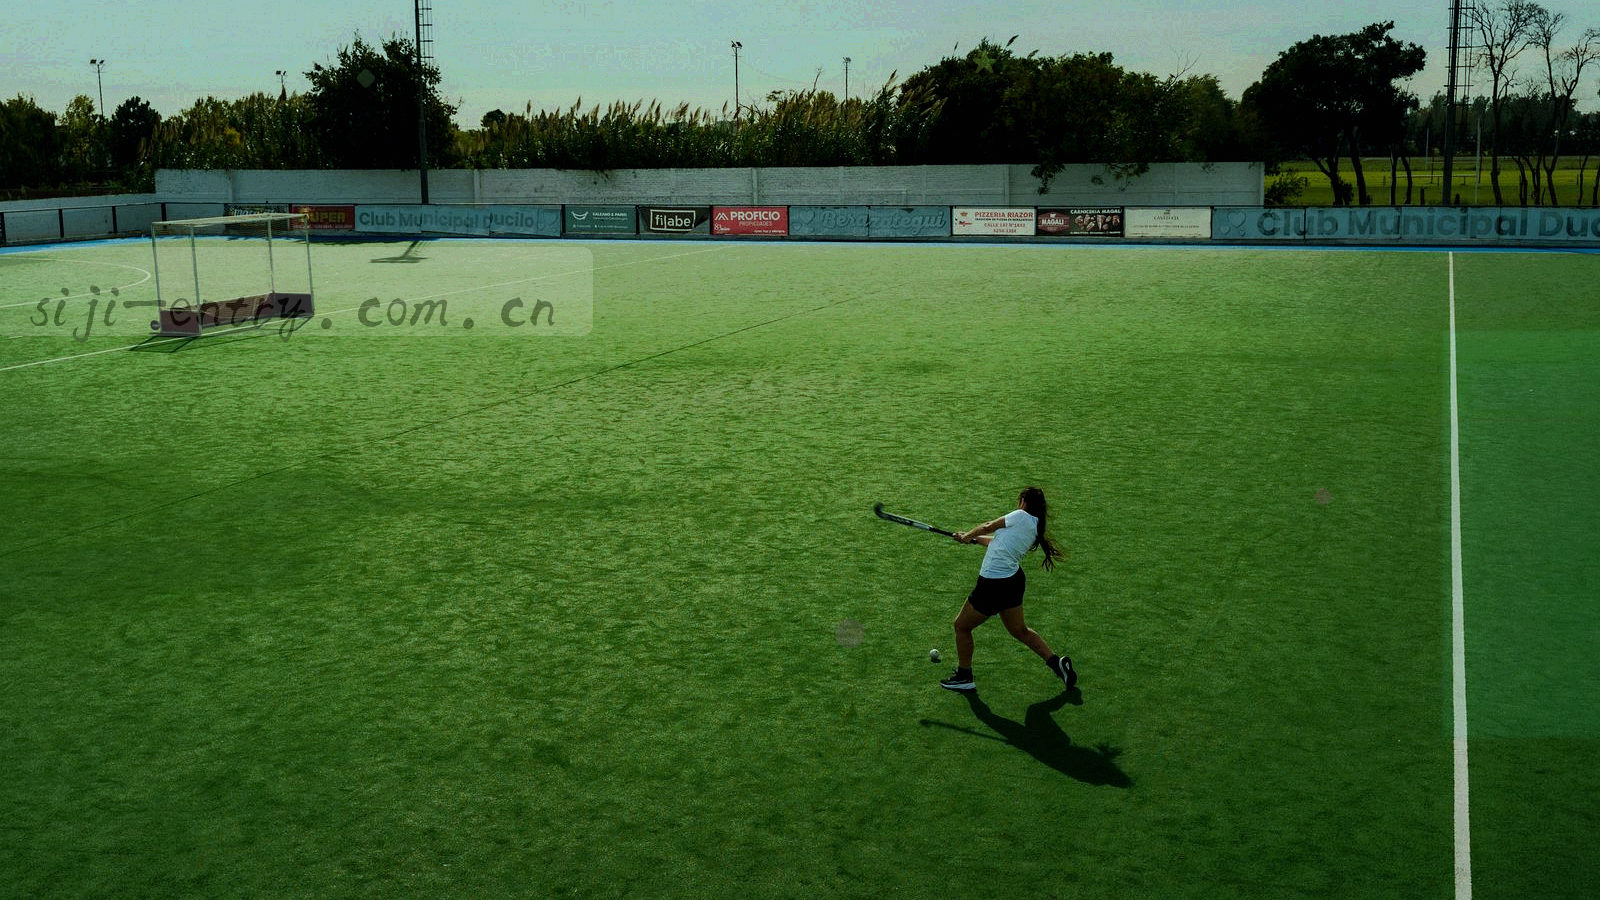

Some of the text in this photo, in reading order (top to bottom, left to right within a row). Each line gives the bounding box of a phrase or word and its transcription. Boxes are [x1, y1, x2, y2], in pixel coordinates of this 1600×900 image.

[359, 211, 395, 227] Club
[400, 212, 478, 231] Municipal
[655, 214, 692, 228] filabe
[730, 211, 781, 221] PROFICIO
[1257, 209, 1339, 237] Club
[1349, 207, 1528, 237] Municipal
